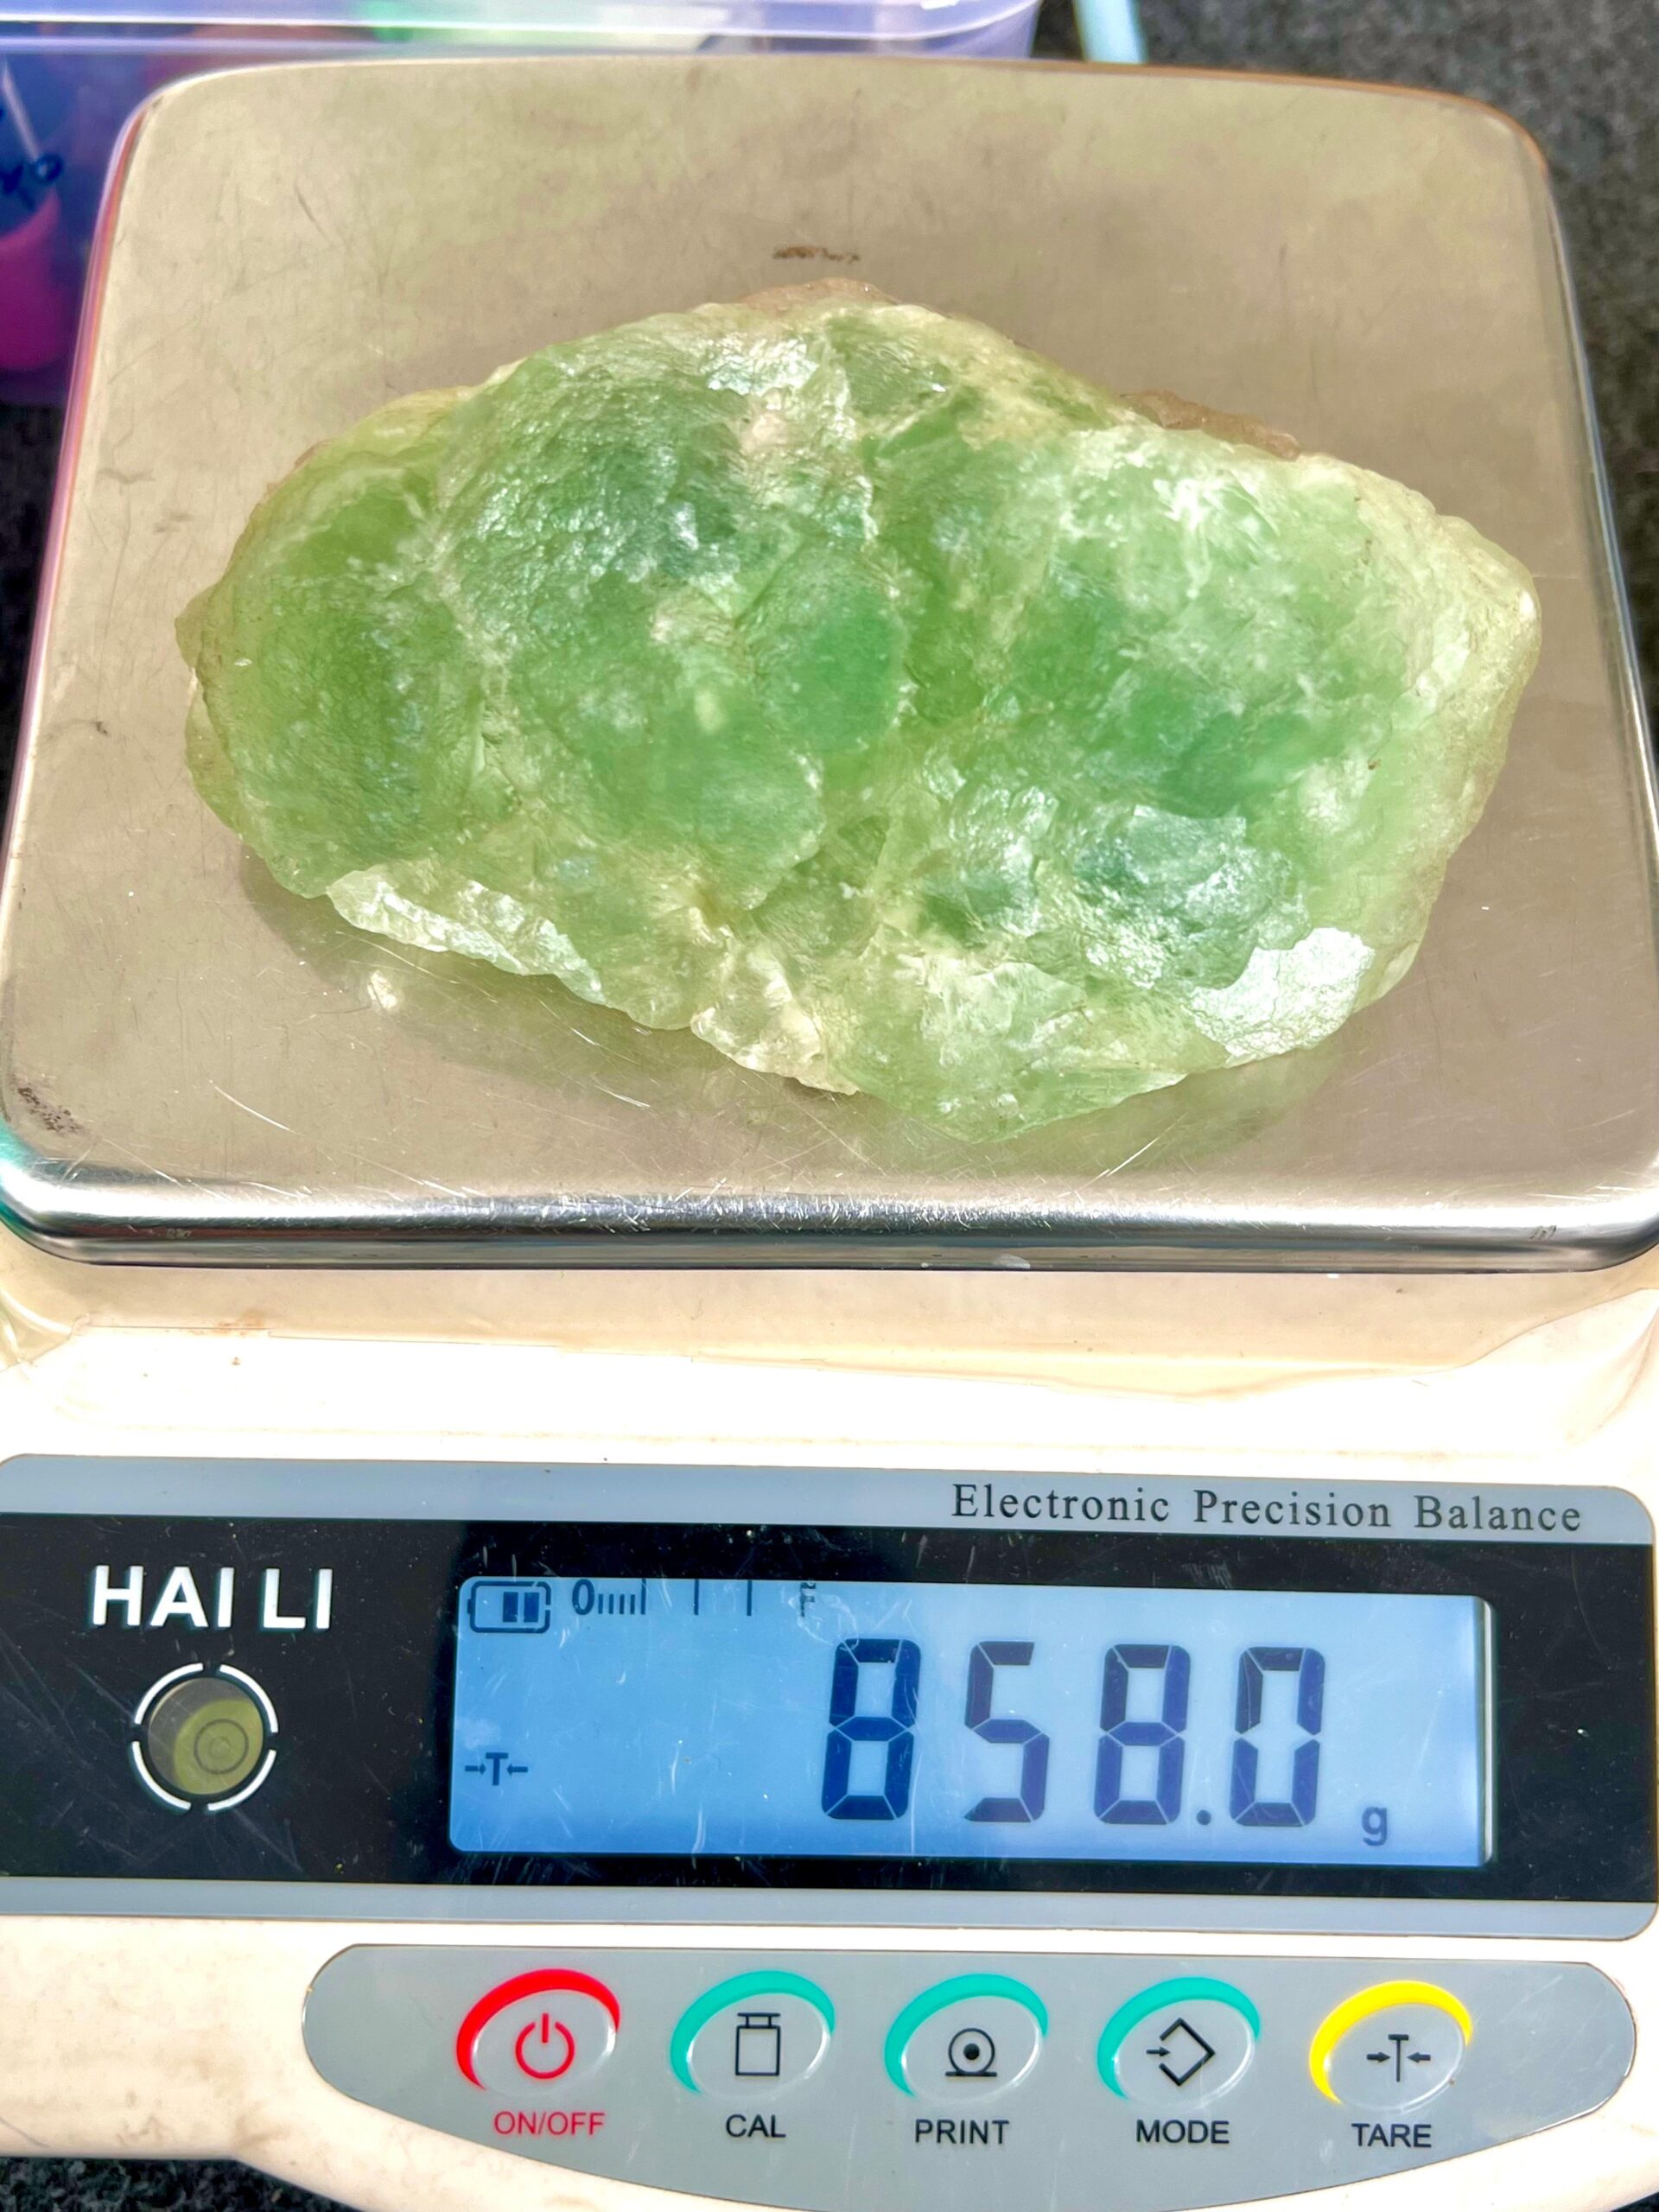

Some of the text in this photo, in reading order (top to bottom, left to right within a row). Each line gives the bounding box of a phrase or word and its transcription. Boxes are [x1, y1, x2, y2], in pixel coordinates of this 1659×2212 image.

[952, 1483, 1581, 1532] Electronic Precision Balance
[821, 1637, 1389, 1847] 858.0 g
[493, 2111, 605, 2137] ON/OFF
[725, 2113, 786, 2139] CAL
[914, 2119, 1010, 2145] PRINT
[1136, 2119, 1230, 2145] MODE
[1351, 2122, 1433, 2149] TARE
